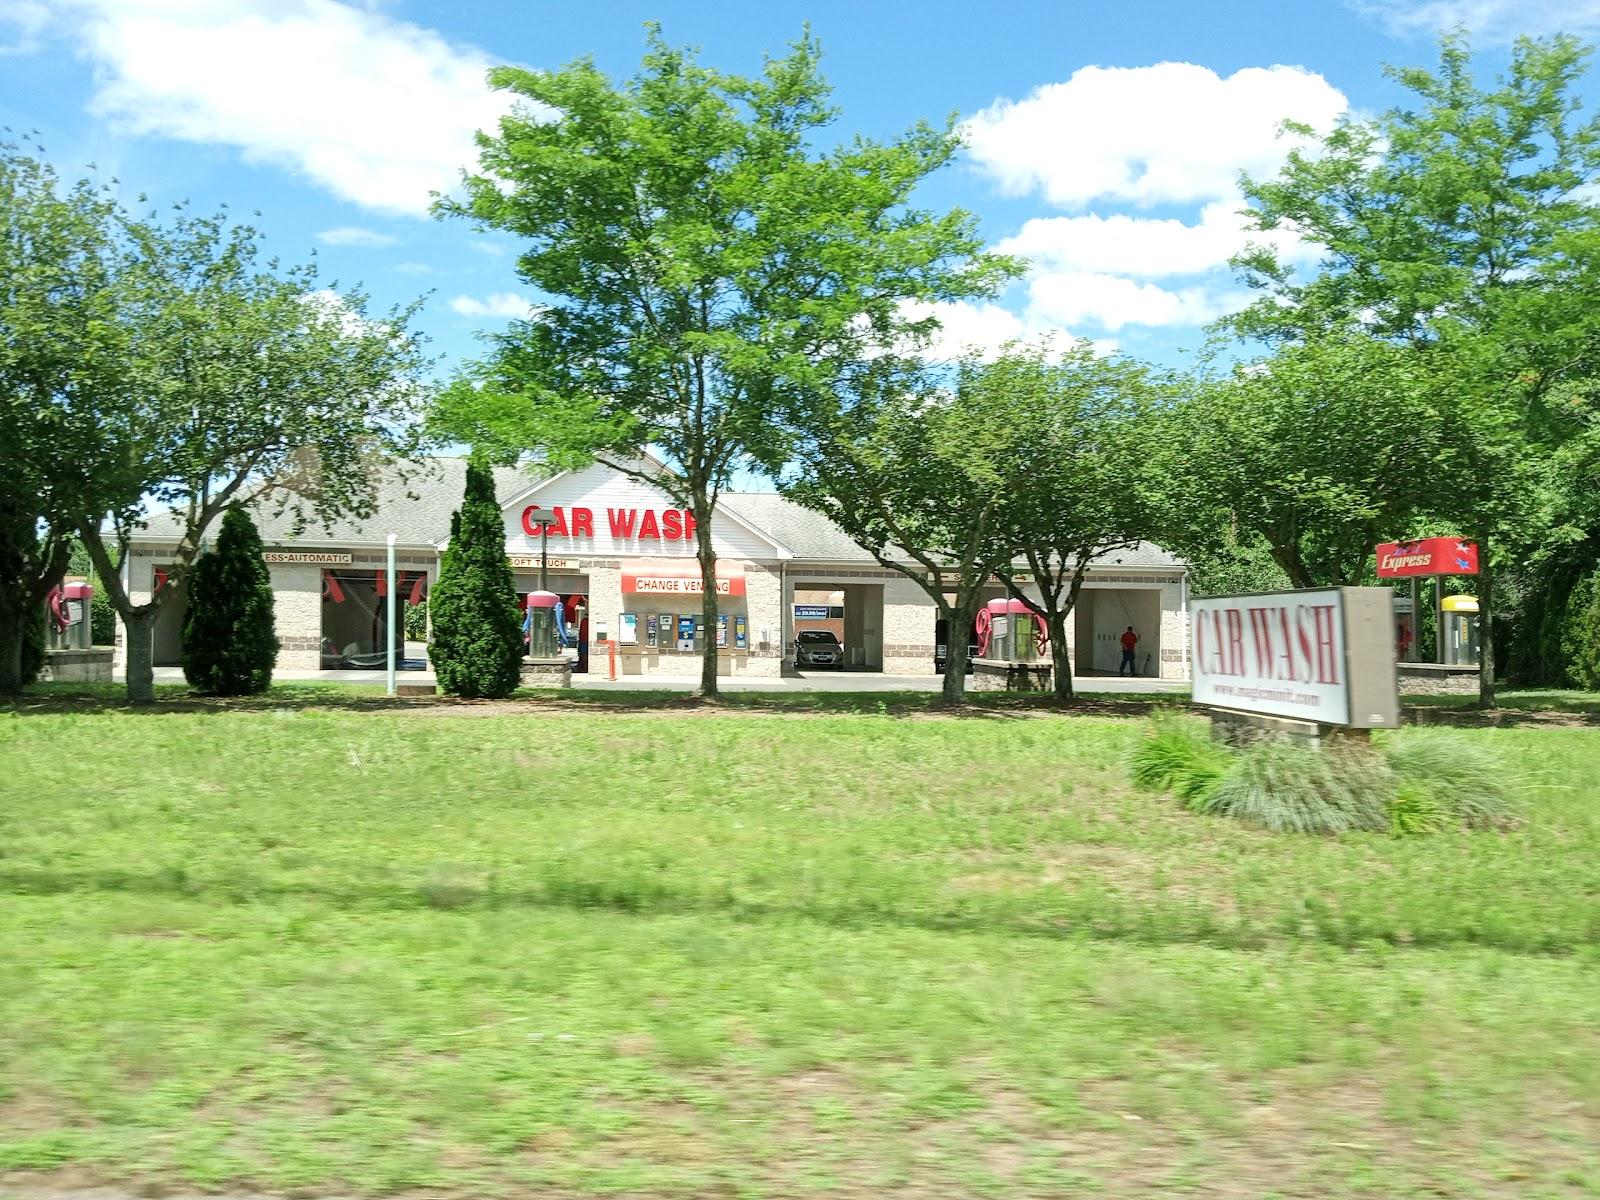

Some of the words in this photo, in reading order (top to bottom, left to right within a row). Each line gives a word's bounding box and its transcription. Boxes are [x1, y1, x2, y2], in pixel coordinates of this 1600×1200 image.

[521, 505, 594, 538] CAR
[265, 553, 349, 563] ESS-AUTOMATIC
[535, 559, 567, 567] TUCH
[1381, 553, 1432, 573] Express
[637, 580, 679, 591] CHANGE
[683, 581, 729, 592] VENNG
[1196, 607, 1246, 677] CAR
[1247, 604, 1341, 685] WASH
